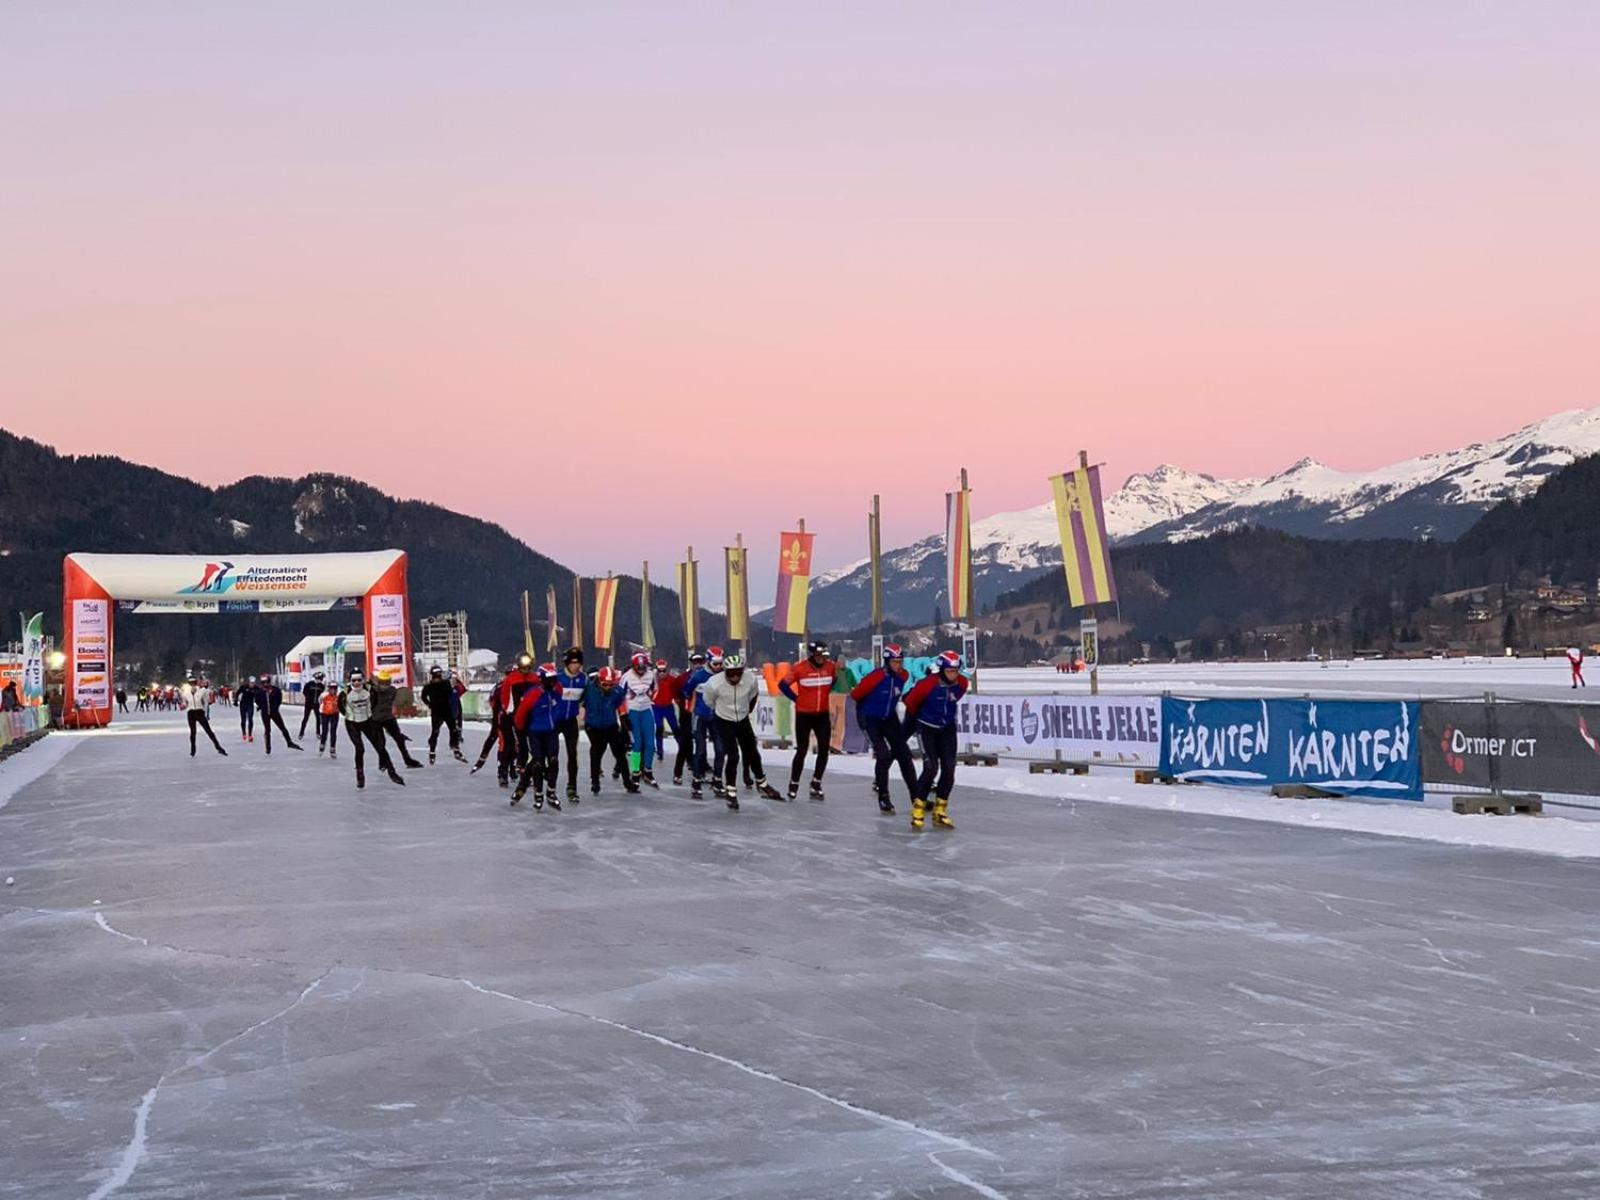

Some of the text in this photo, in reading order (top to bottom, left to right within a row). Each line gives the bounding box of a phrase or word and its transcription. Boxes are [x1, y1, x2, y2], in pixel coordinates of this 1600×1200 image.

[247, 566, 308, 575] Alternatieve
[236, 574, 308, 584] Elfstedentocht
[235, 582, 307, 591] Weissensee
[196, 599, 215, 609] kpn
[275, 599, 294, 608] kpn
[973, 703, 1015, 736] JELLE
[1041, 704, 1103, 740] SNELLE
[1106, 706, 1159, 743] JELLE
[1451, 729, 1537, 757] Ormer ICT
